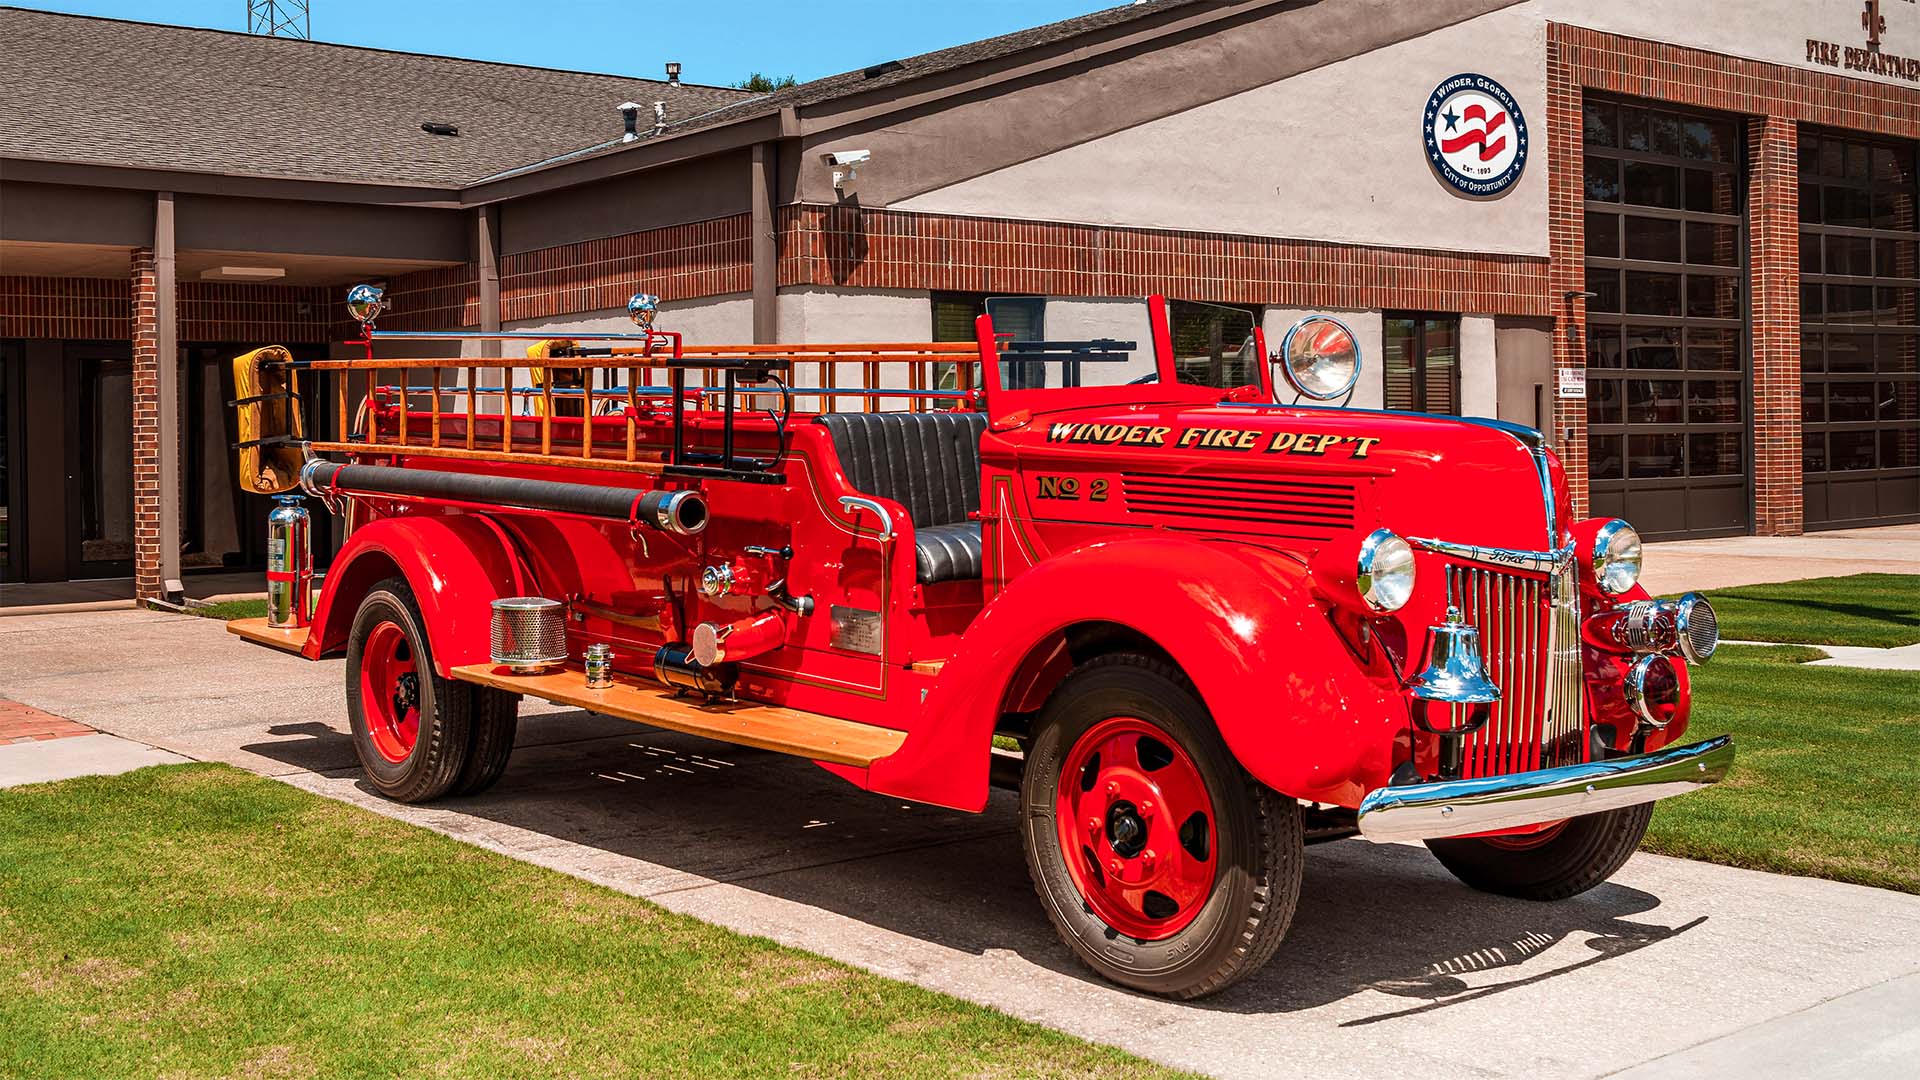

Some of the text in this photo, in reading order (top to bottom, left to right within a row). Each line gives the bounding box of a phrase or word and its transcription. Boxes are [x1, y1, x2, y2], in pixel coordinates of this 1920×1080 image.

[1806, 39, 1840, 67] FIRE
[1437, 78, 1514, 109] WINDER, GEORGIA
[1048, 422, 1379, 459] WINDER FIRE DEP'T
[1090, 478, 1110, 501] 2
[1489, 548, 1525, 565] Ford
